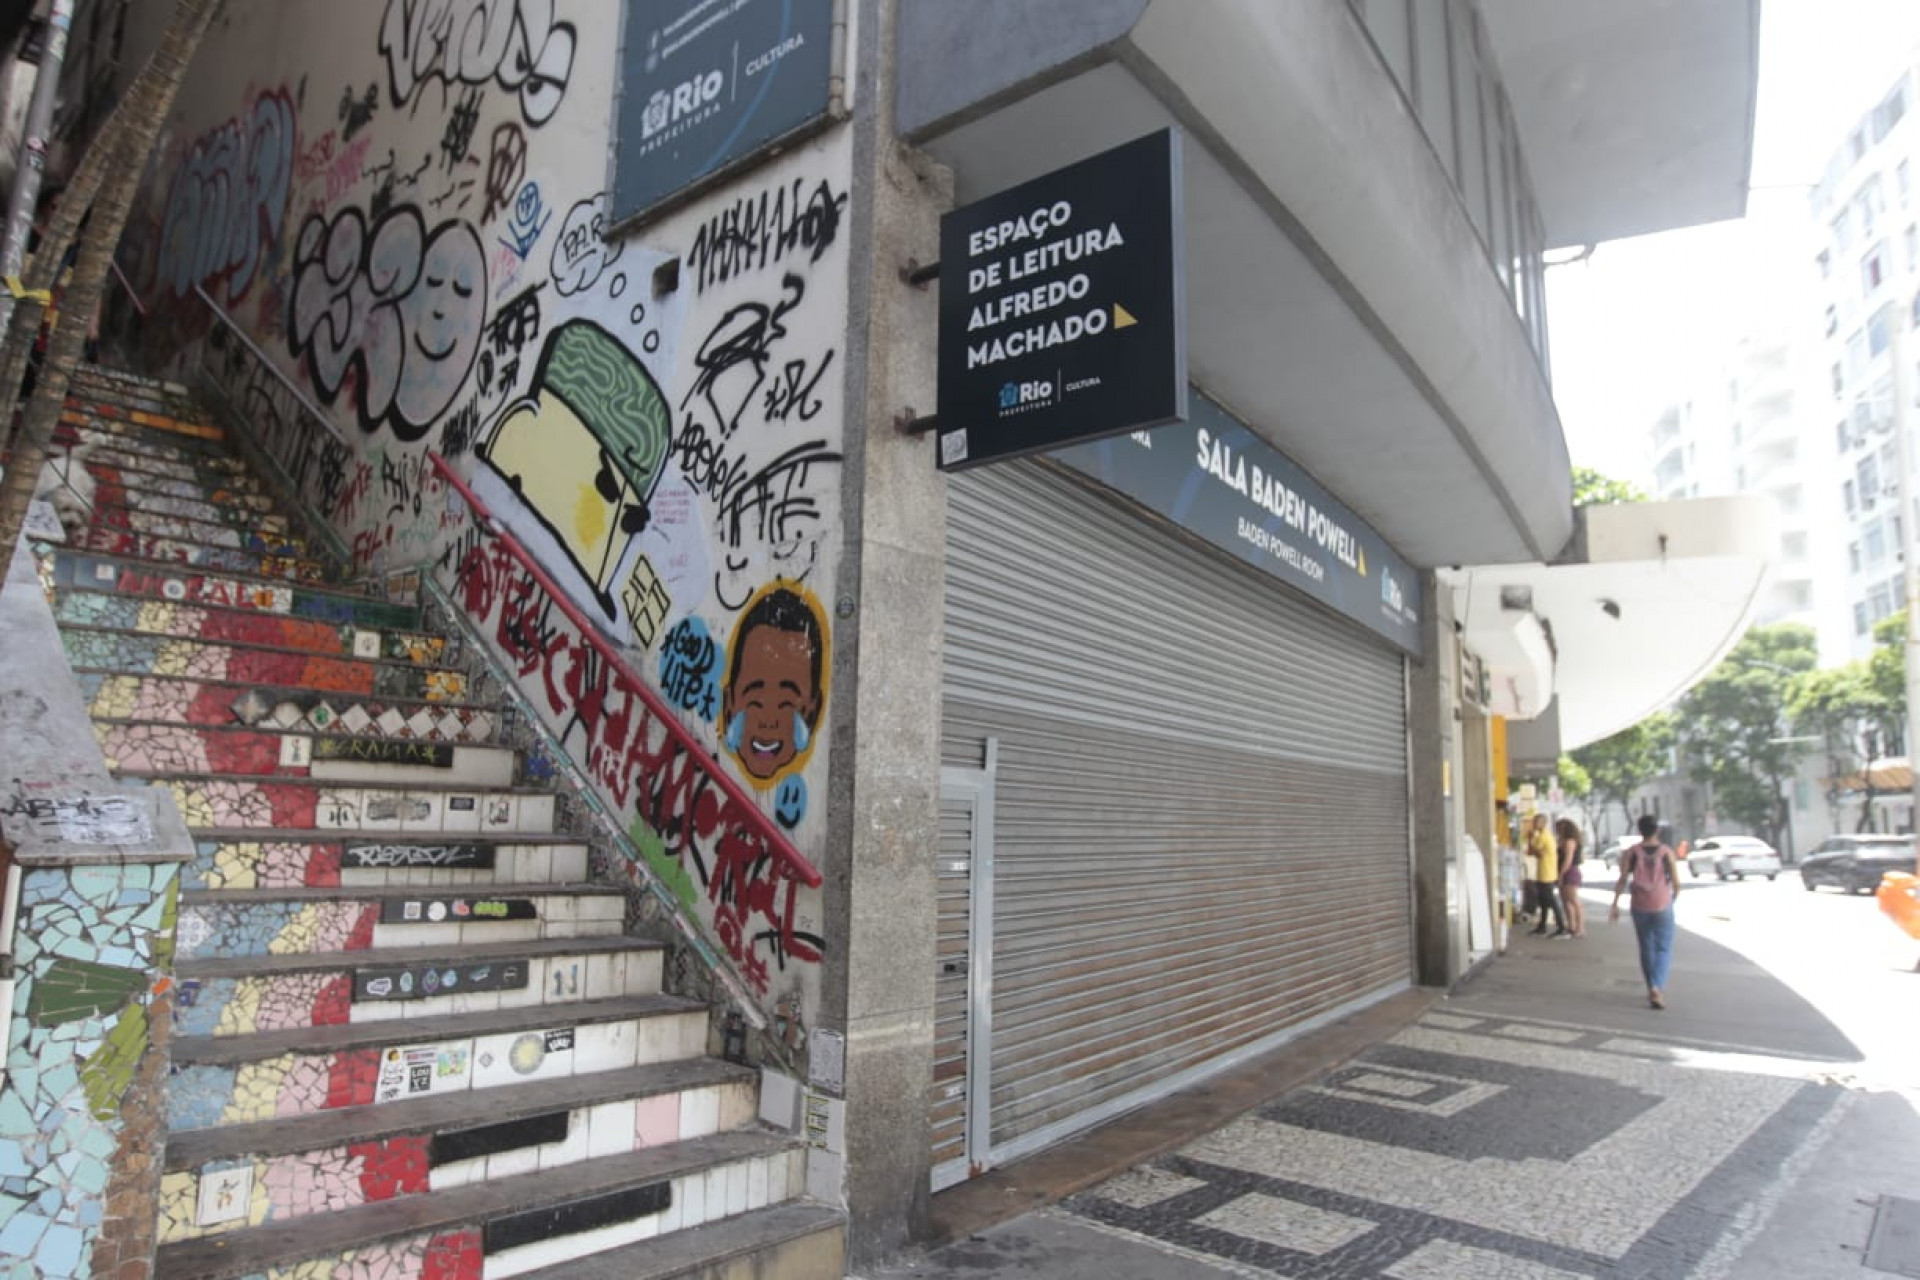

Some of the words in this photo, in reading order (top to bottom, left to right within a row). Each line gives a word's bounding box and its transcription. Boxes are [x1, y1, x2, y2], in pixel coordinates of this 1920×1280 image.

[672, 69, 724, 122] Rio
[745, 32, 805, 77] CULTURA
[968, 201, 1072, 257] ESPAÇO
[968, 263, 1001, 294] DE
[1009, 222, 1124, 282] LEITURA
[967, 273, 1091, 332] ALFREDO
[967, 308, 1108, 370] MACHADO
[1020, 380, 1053, 404] Rio
[1066, 376, 1101, 392] CULTURA
[1197, 427, 1248, 498] SALA
[1251, 464, 1307, 534] BADEN
[1307, 504, 1358, 570] POWELL
[1238, 516, 1270, 552] BADEN
[1270, 535, 1302, 570] POWELL
[1301, 554, 1325, 583] ROOM
